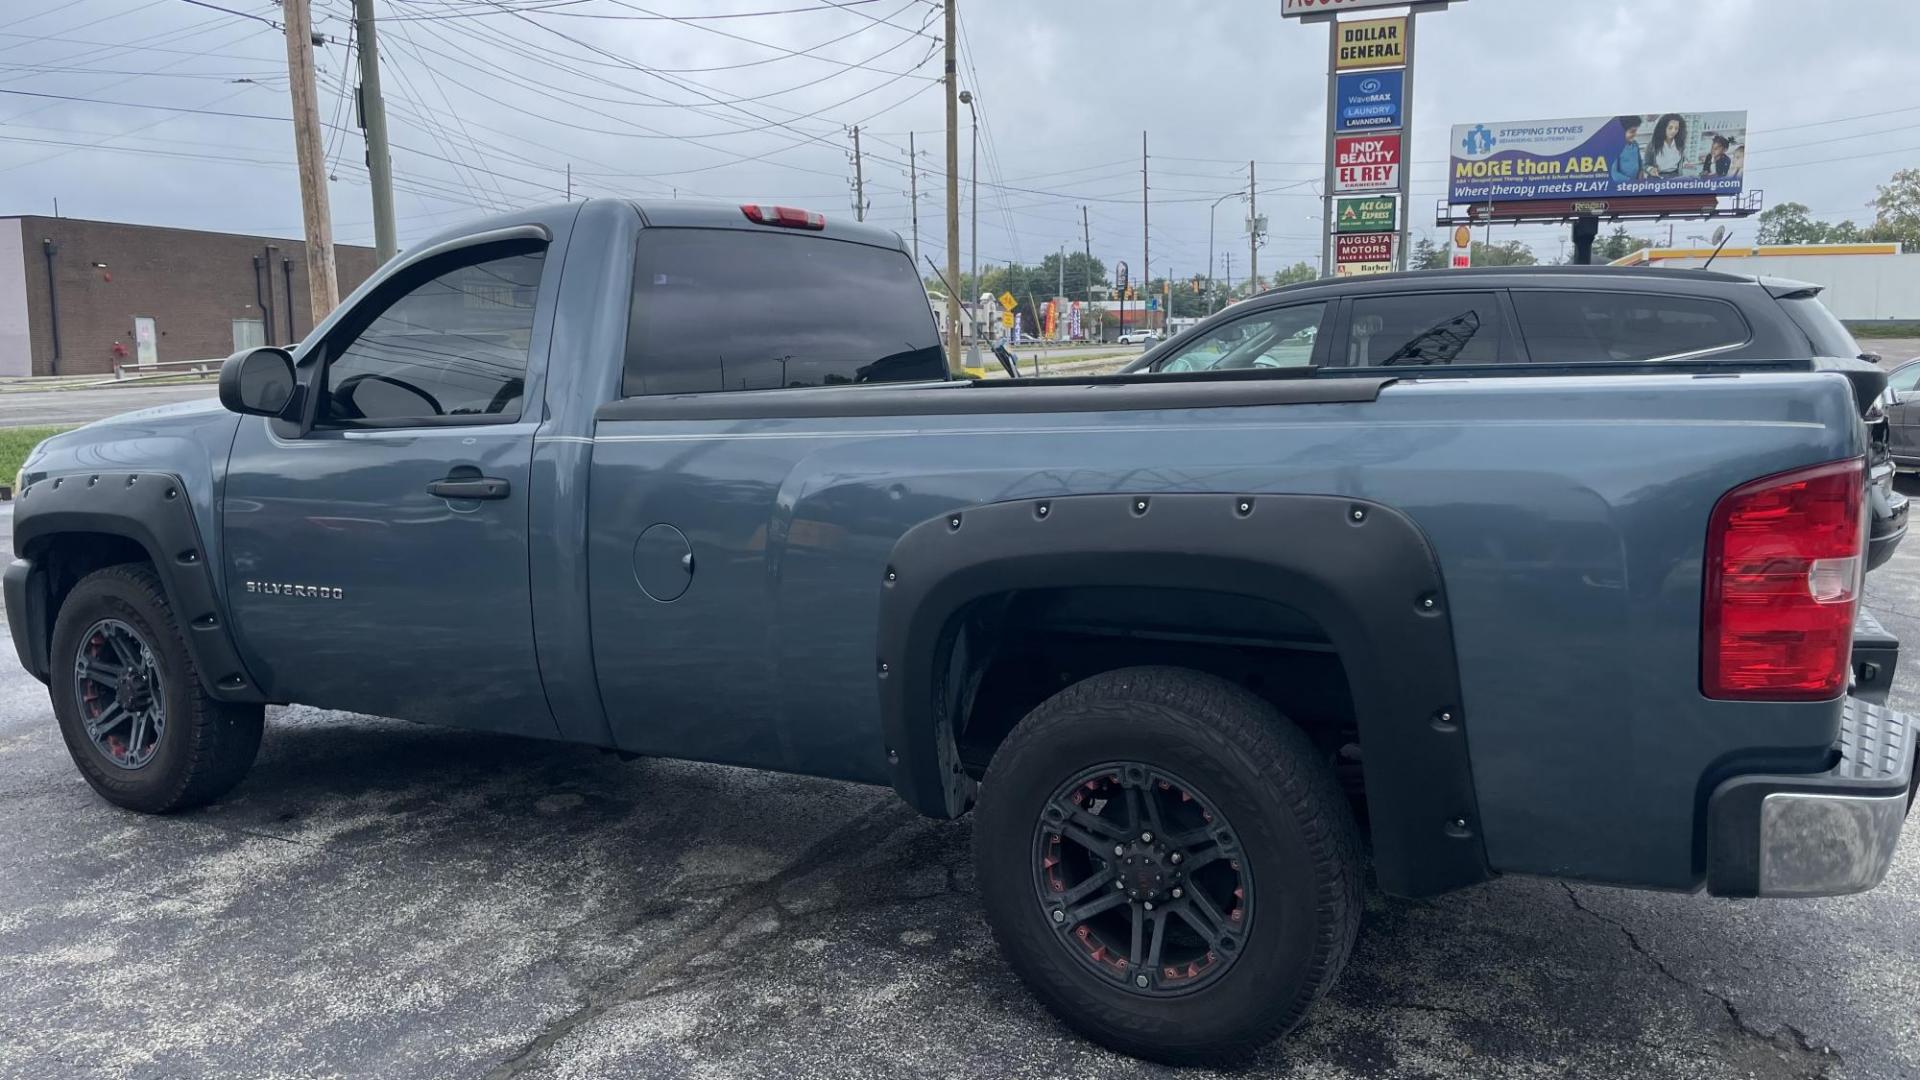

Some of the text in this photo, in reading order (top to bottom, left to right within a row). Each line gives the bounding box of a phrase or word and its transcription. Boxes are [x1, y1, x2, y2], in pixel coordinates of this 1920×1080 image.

[1345, 26, 1397, 42] DOLLAR
[1341, 43, 1400, 60] GENERAL
[1348, 93, 1391, 103] WaveMAX
[1348, 106, 1391, 116] LAUNDRY
[1346, 117, 1391, 127] LAVANDERIA
[1500, 125, 1583, 137] STEPPING STONES
[1350, 141, 1384, 153] INDY
[1340, 150, 1394, 164] BEAUTY
[1456, 160, 1512, 178] MORE
[1516, 159, 1560, 175] than
[1565, 156, 1608, 173] ABA
[1340, 166, 1393, 182] EL REY
[1454, 179, 1740, 197] Where therapy meets PLAY! steppingstonesindy.com
[1359, 202, 1375, 211] ACE
[1340, 235, 1390, 245] AUGUSTA
[1342, 245, 1387, 254] MOTORS
[1361, 264, 1389, 272] Barber
[246, 581, 343, 600] SILVERADO
